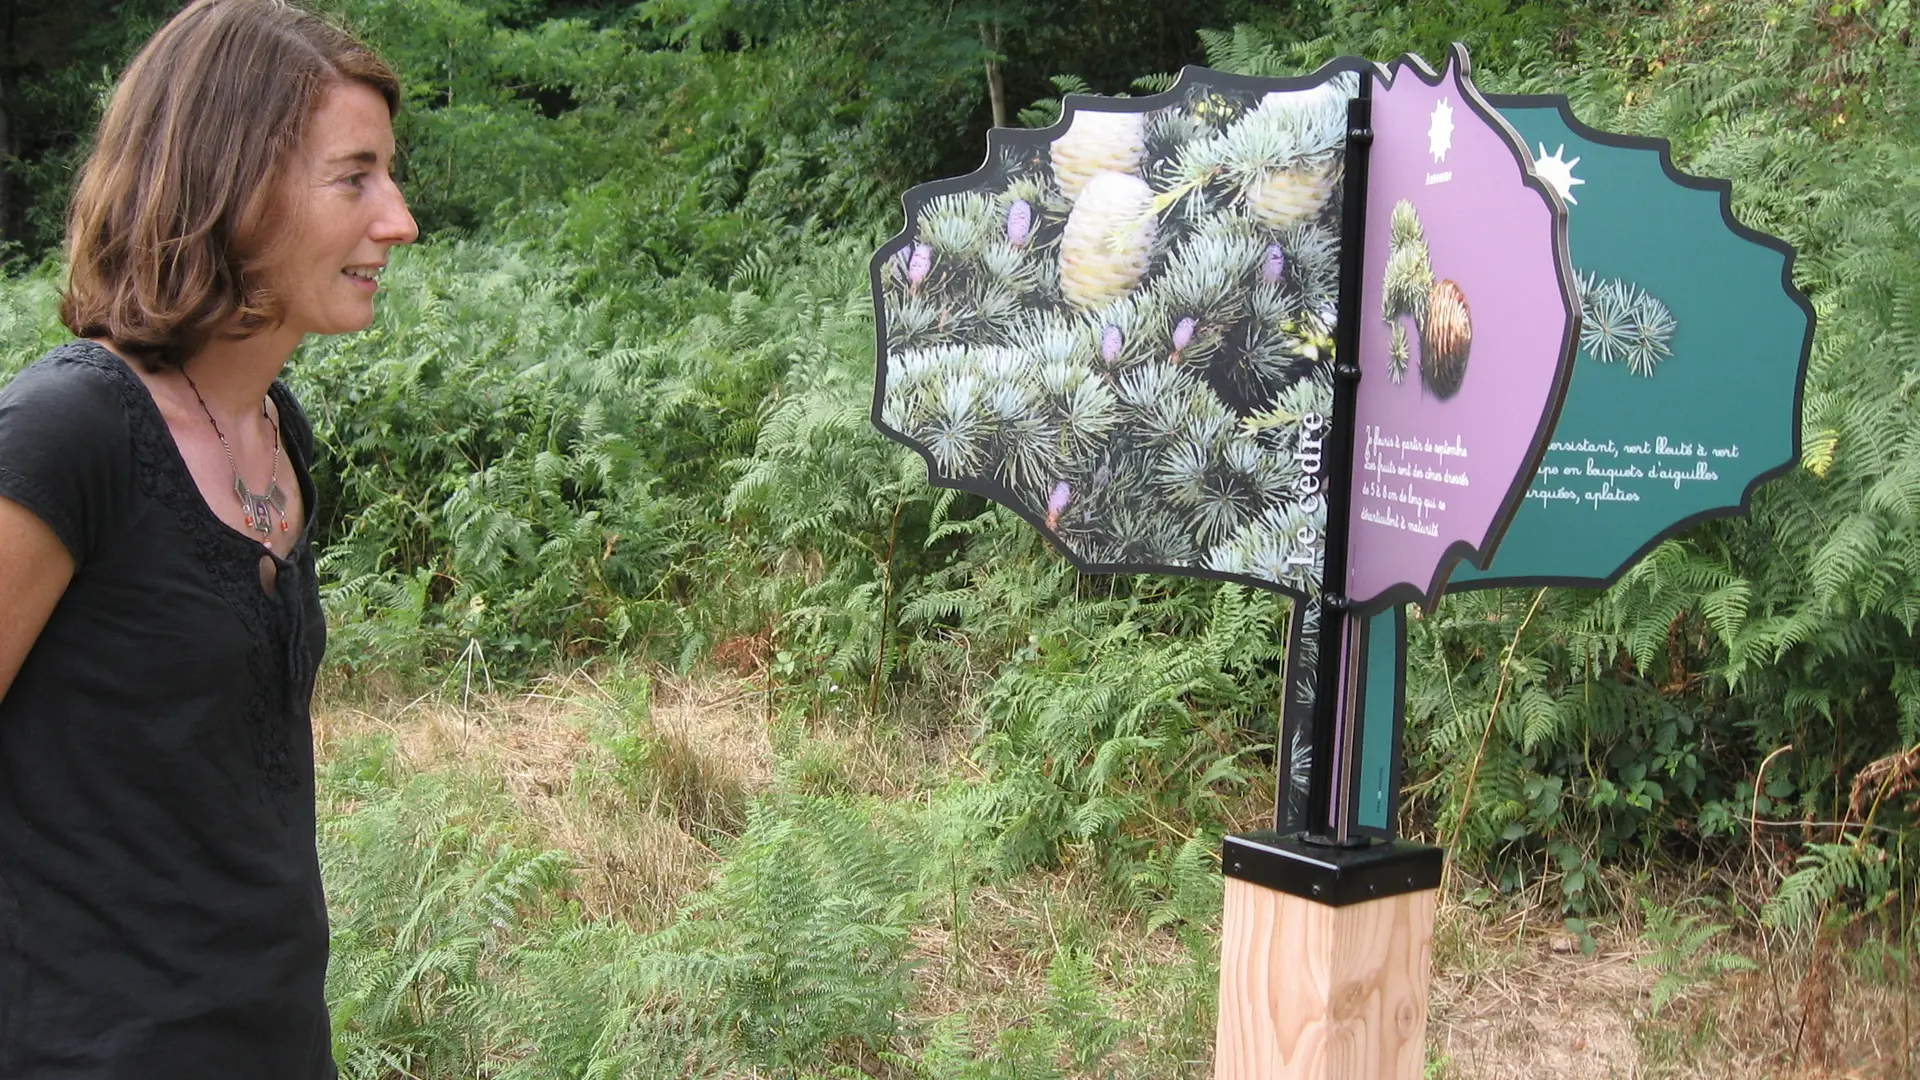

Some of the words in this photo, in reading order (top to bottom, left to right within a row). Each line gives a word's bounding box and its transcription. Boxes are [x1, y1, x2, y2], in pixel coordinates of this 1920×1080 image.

[1291, 411, 1324, 514] cèdre
[1401, 436, 1424, 460] partir
[1424, 437, 1433, 452] de
[1434, 434, 1468, 466] septembre
[1547, 438, 1619, 458] ersistant,
[1623, 440, 1651, 455] vert
[1655, 435, 1693, 456] bleuté
[1696, 443, 1708, 457] à
[1712, 444, 1740, 458] vert
[1377, 452, 1396, 483] fruits
[1397, 462, 1411, 477] sont
[1412, 463, 1424, 478] des
[1424, 466, 1443, 482] cônes
[1563, 466, 1583, 476] en
[1586, 457, 1644, 487] bouquets
[1647, 460, 1719, 490] d'aiguilles
[1362, 481, 1370, 496] de
[1370, 482, 1375, 496] 5
[1375, 483, 1381, 498] à
[1382, 484, 1387, 499] 8
[1387, 491, 1398, 502] cm
[1399, 488, 1407, 504] de
[1407, 483, 1423, 518] long
[1423, 498, 1437, 519] qui
[1438, 500, 1447, 511] se
[1584, 482, 1640, 510] aplaties
[1407, 518, 1439, 537] maturité
[1287, 526, 1317, 567] Le
